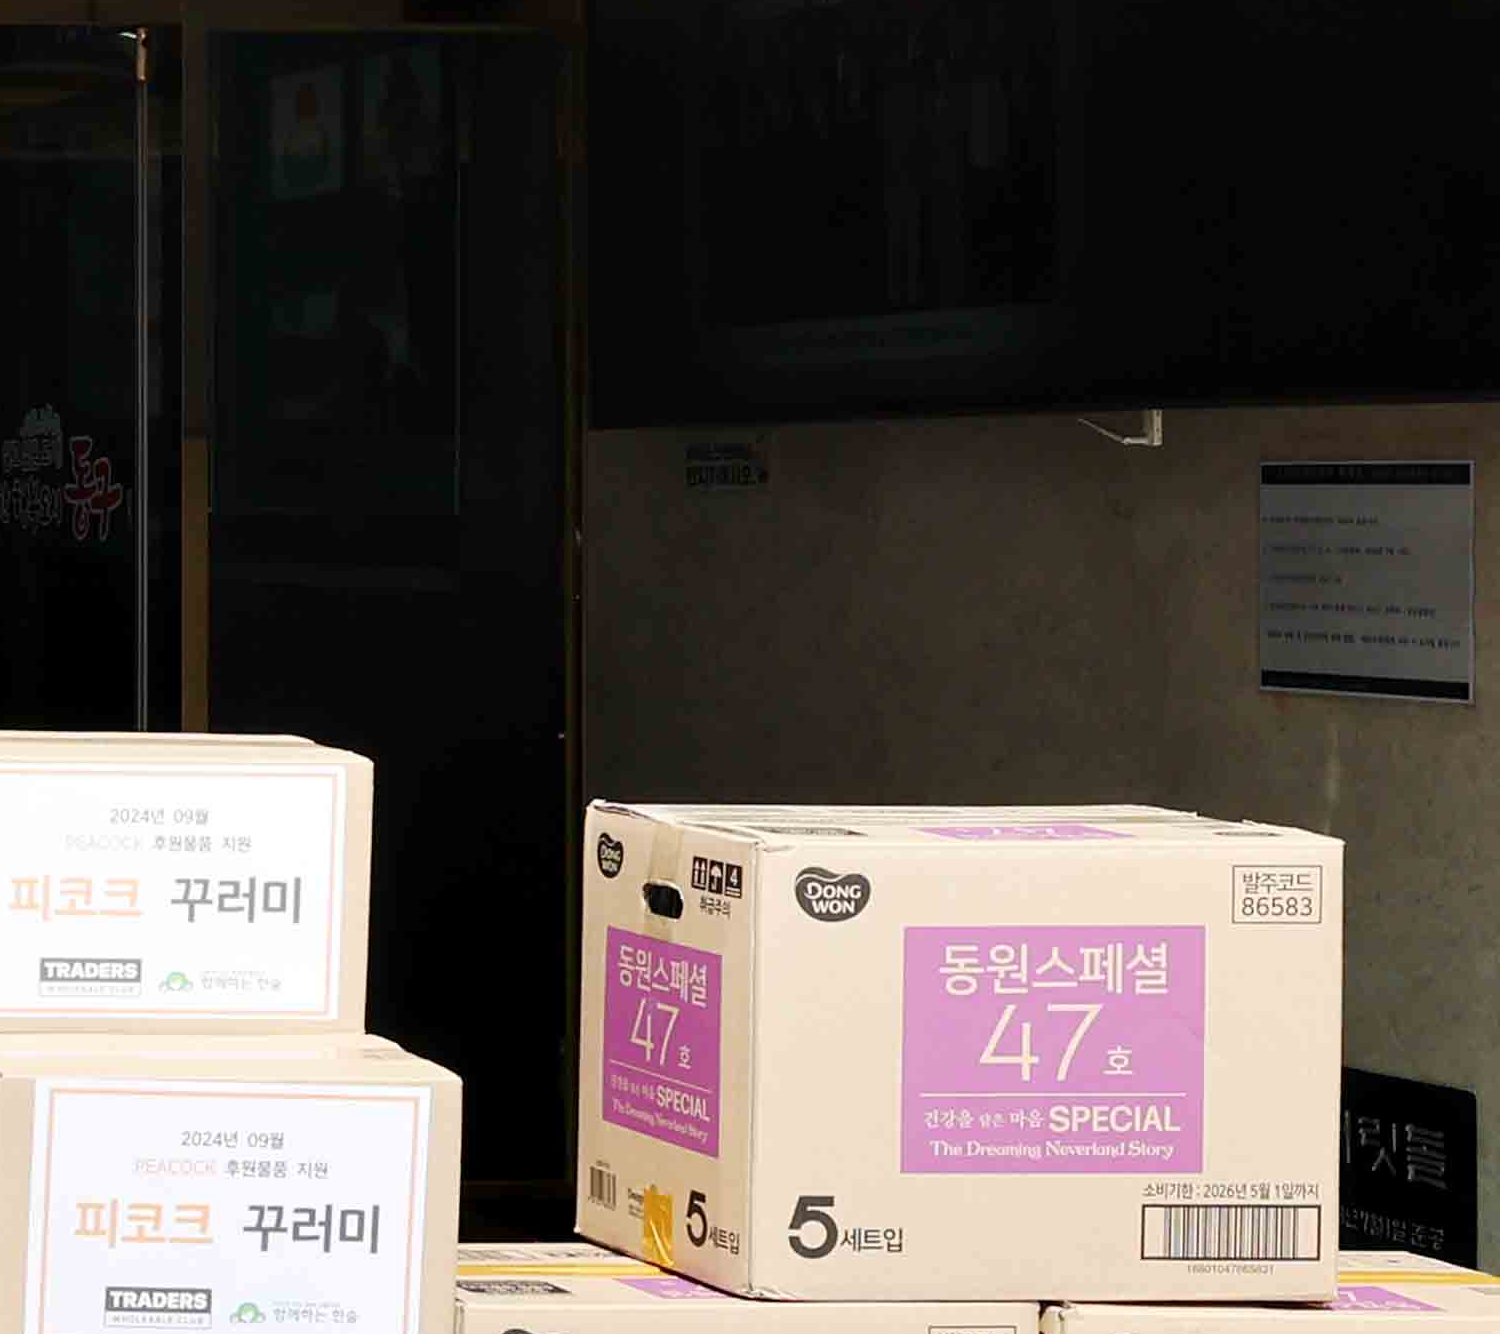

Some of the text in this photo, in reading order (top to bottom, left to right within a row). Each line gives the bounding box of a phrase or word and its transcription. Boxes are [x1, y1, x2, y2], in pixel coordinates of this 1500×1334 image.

[1241, 896, 1313, 917] 86583
[1242, 871, 1314, 895] 발주코드
[617, 944, 708, 1008] 동원스페셜
[938, 939, 1169, 996] 동원스페셜
[630, 997, 680, 1067] 47
[979, 1002, 1133, 1084] 47 호
[656, 1083, 711, 1122] SPECIAL
[1048, 1104, 1181, 1133] SPECIAL
[73, 1198, 380, 1255] 피코크 꾸러미
